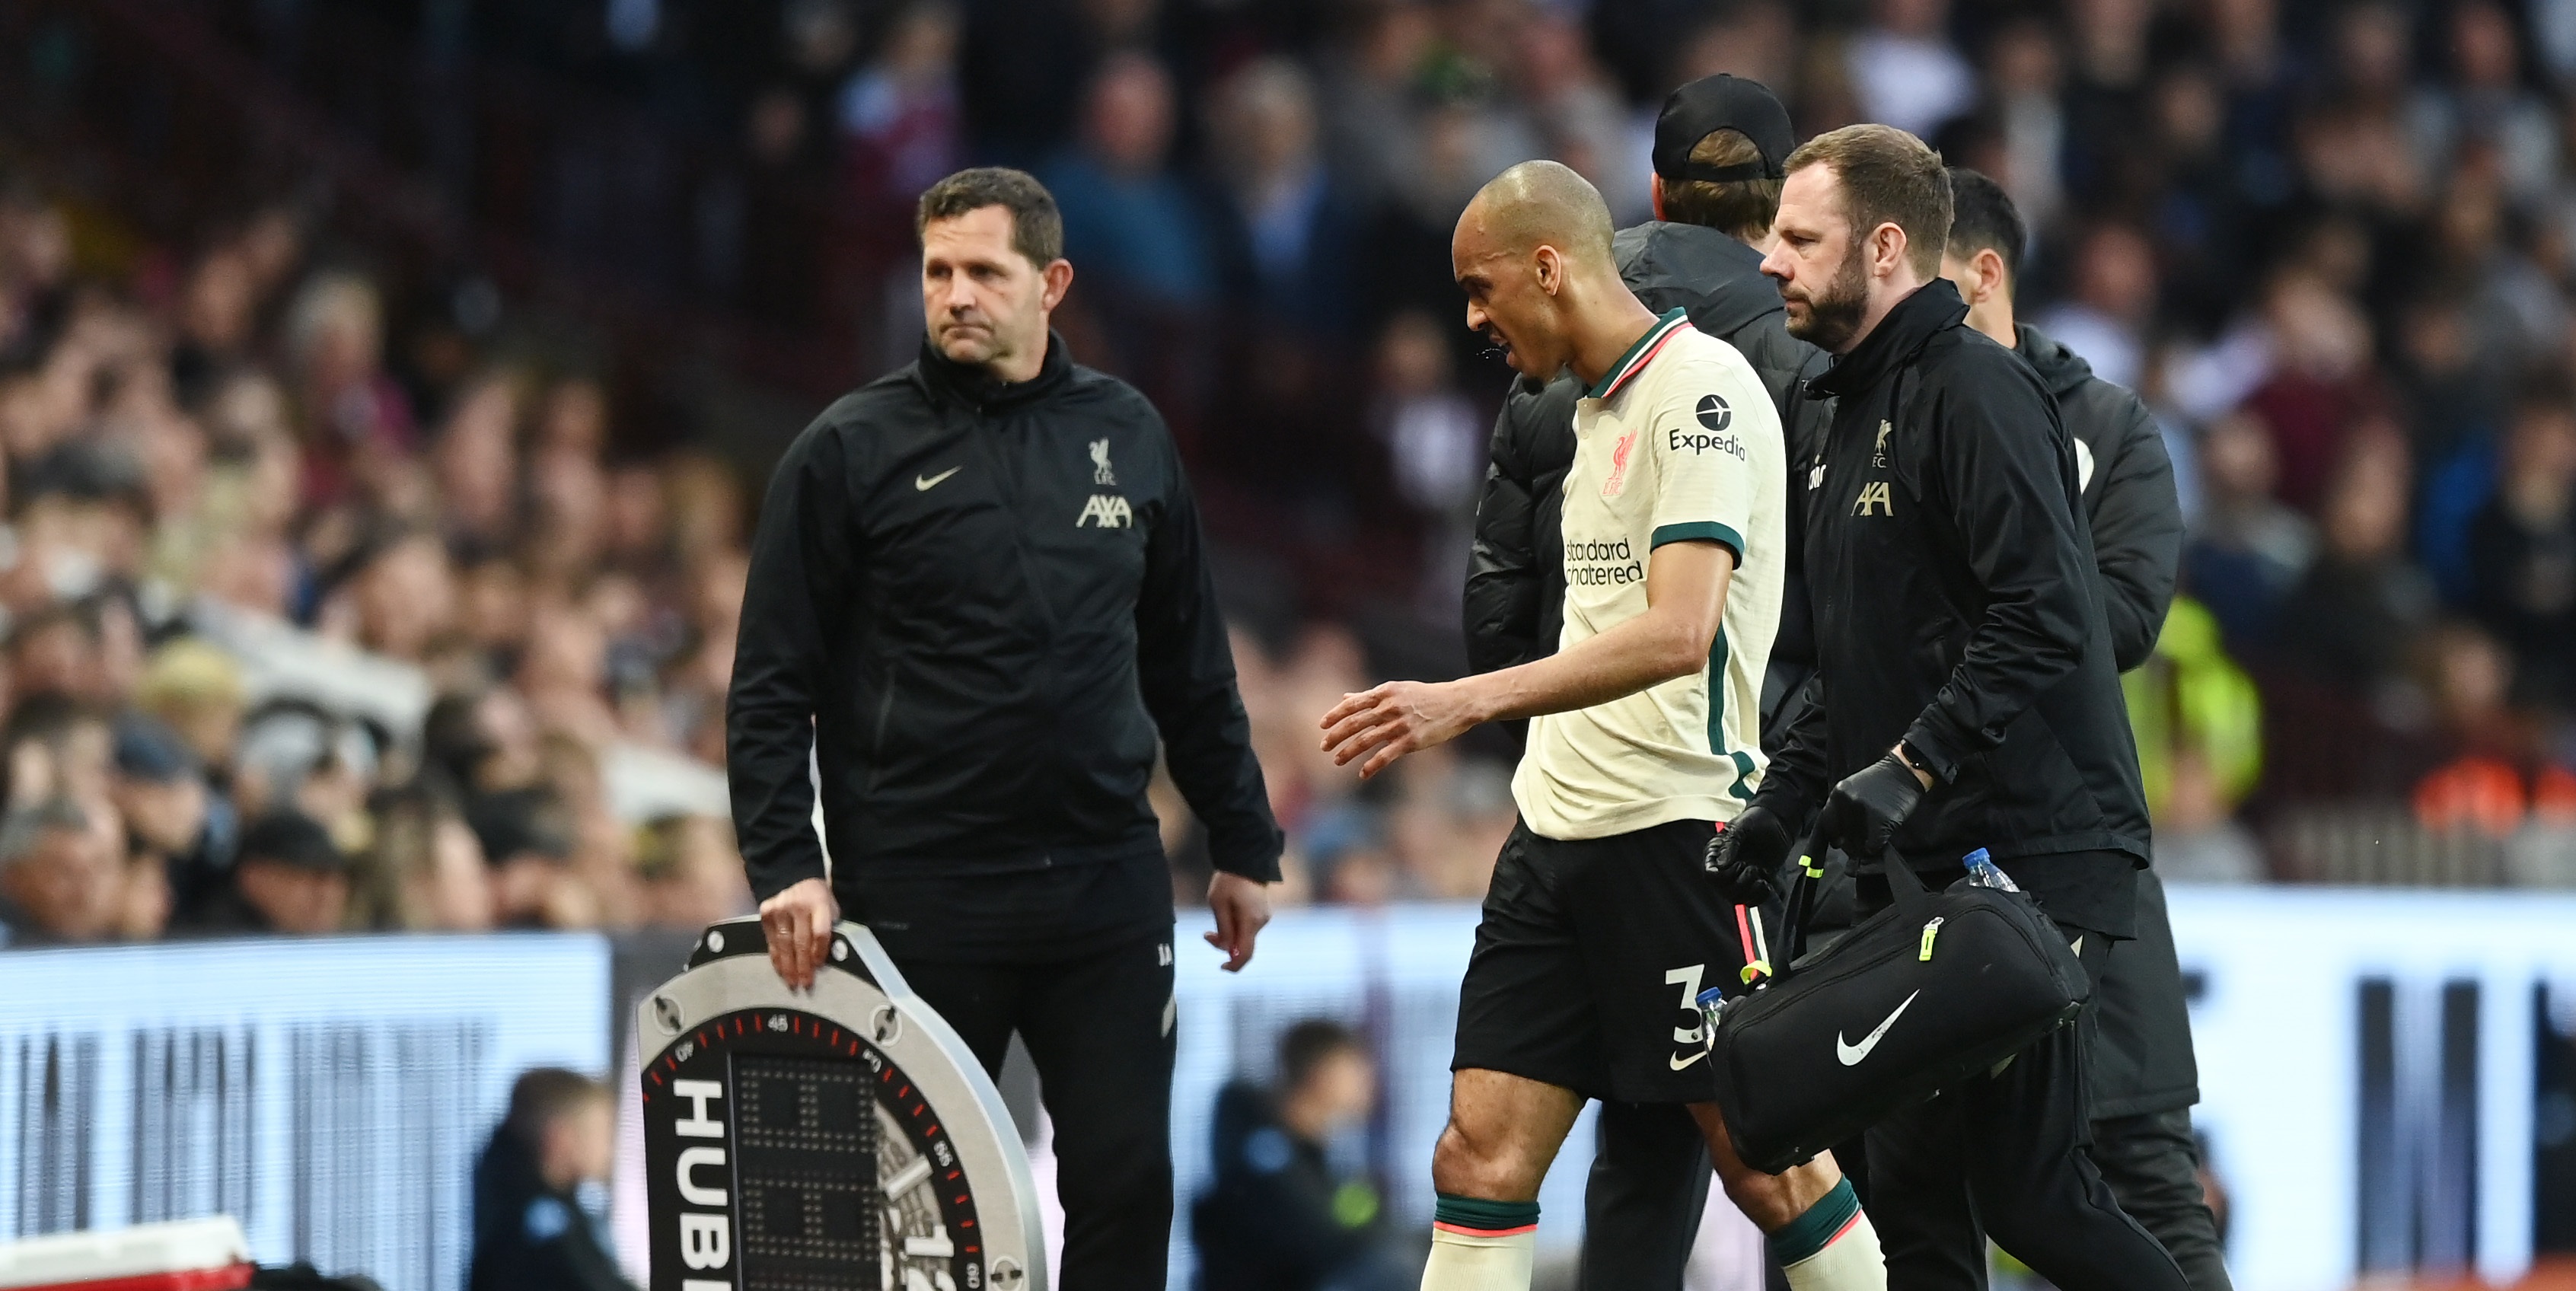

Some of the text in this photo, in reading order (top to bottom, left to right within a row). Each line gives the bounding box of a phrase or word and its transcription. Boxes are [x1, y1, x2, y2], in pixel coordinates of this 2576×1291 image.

[1669, 428, 1745, 461] Expedia
[1076, 494, 1133, 529] AXA
[673, 1078, 732, 1291] HUB
